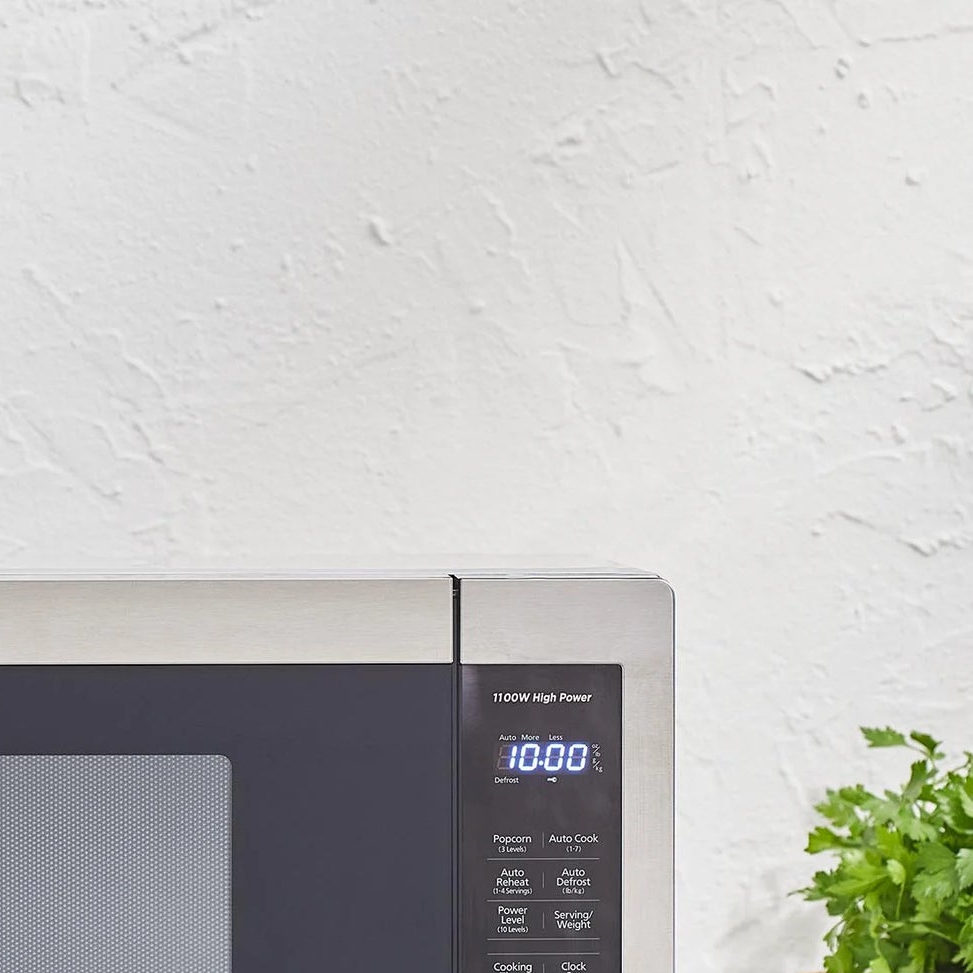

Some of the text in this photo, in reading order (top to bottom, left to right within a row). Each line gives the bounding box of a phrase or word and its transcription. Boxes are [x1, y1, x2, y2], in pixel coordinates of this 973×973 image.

[493, 693, 592, 704] 1100W High Power
[493, 835, 531, 845] Popcorn
[549, 834, 599, 842] Auto Cook
[501, 868, 524, 876] Auto
[561, 868, 585, 876] Auto
[496, 878, 529, 886] Reheat
[557, 878, 591, 886] Defrost
[498, 906, 527, 915] Power
[501, 916, 524, 924] Level
[554, 911, 594, 921] Serving/
[557, 920, 591, 930] Weight
[494, 962, 532, 973] Cooking
[561, 962, 586, 971] Clock
